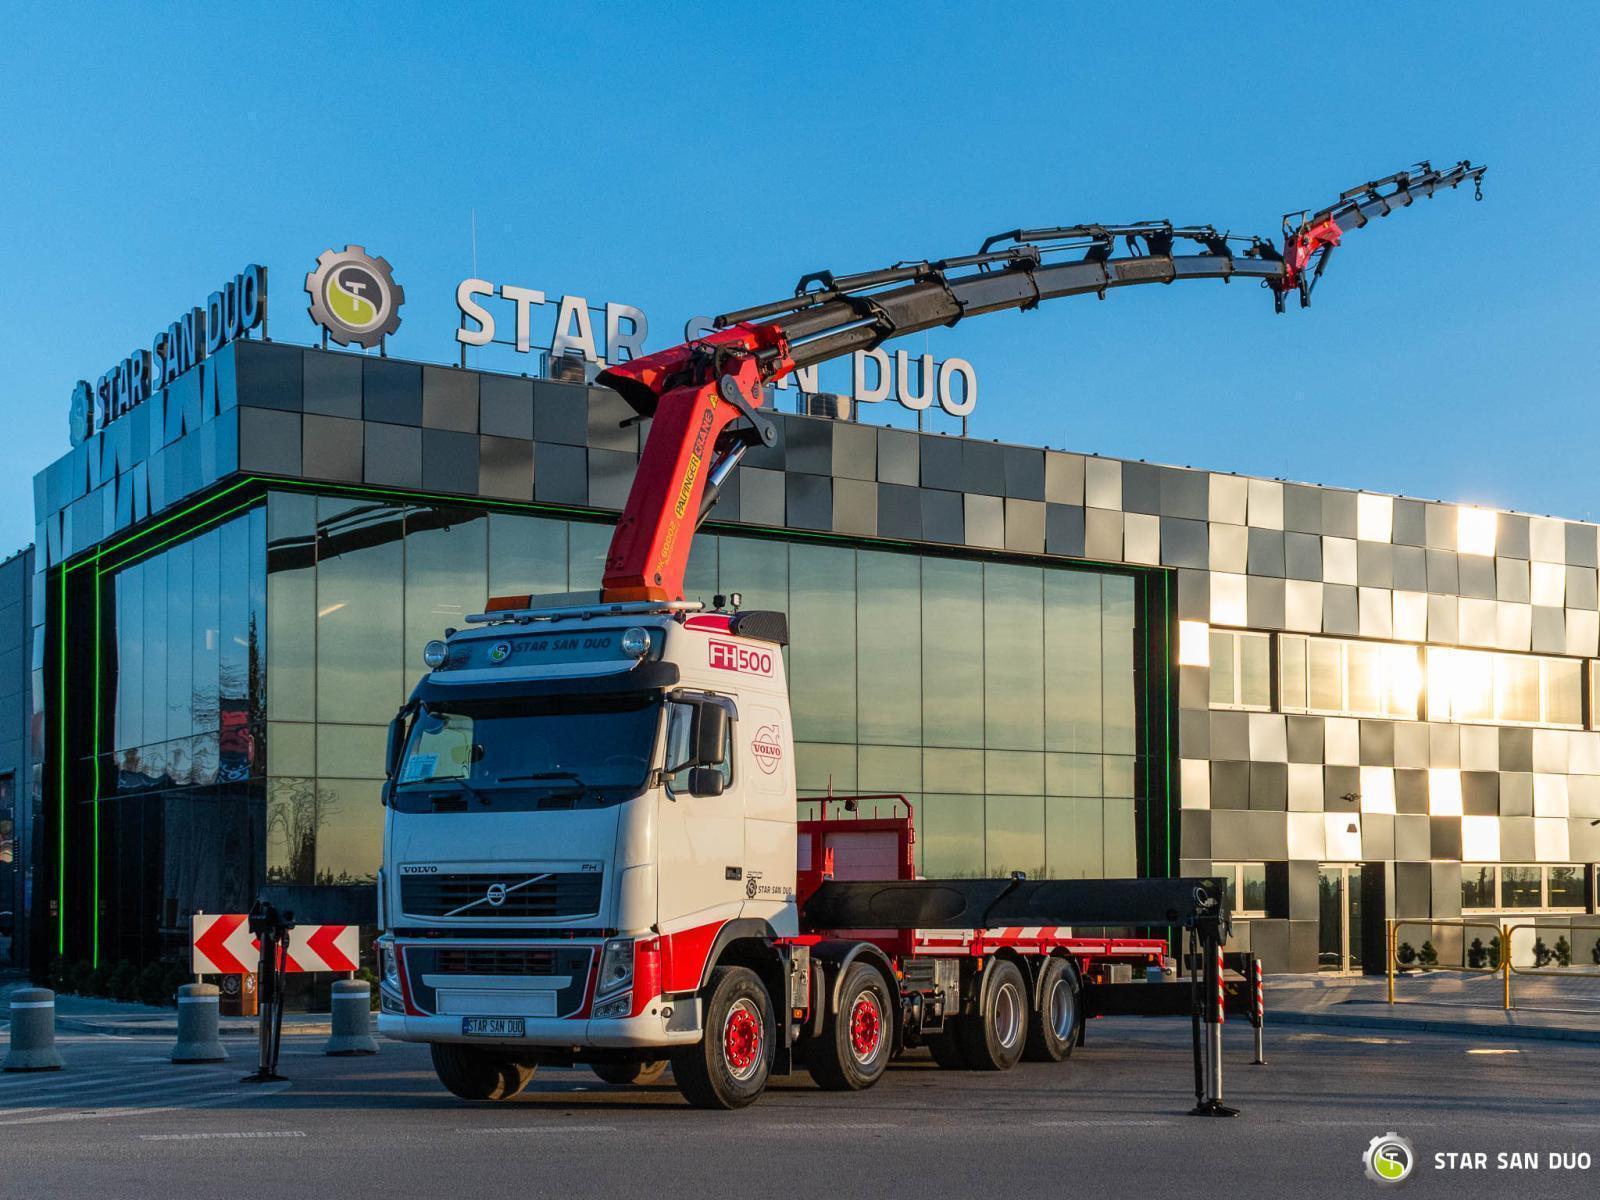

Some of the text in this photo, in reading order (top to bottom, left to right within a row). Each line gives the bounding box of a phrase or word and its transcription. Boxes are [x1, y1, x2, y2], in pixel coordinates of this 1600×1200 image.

[97, 264, 263, 430] STAR SAN DUO
[456, 278, 648, 365] STAR
[853, 346, 977, 417] DUO
[674, 456, 701, 517] PALFINGER
[515, 637, 611, 653] STAR SAN DUO
[753, 743, 781, 756] VOLVO
[581, 863, 597, 872] FH
[758, 885, 771, 894] STAR
[468, 1019, 487, 1032] STAR
[490, 1019, 505, 1032] SAN
[508, 1019, 523, 1033] DUO
